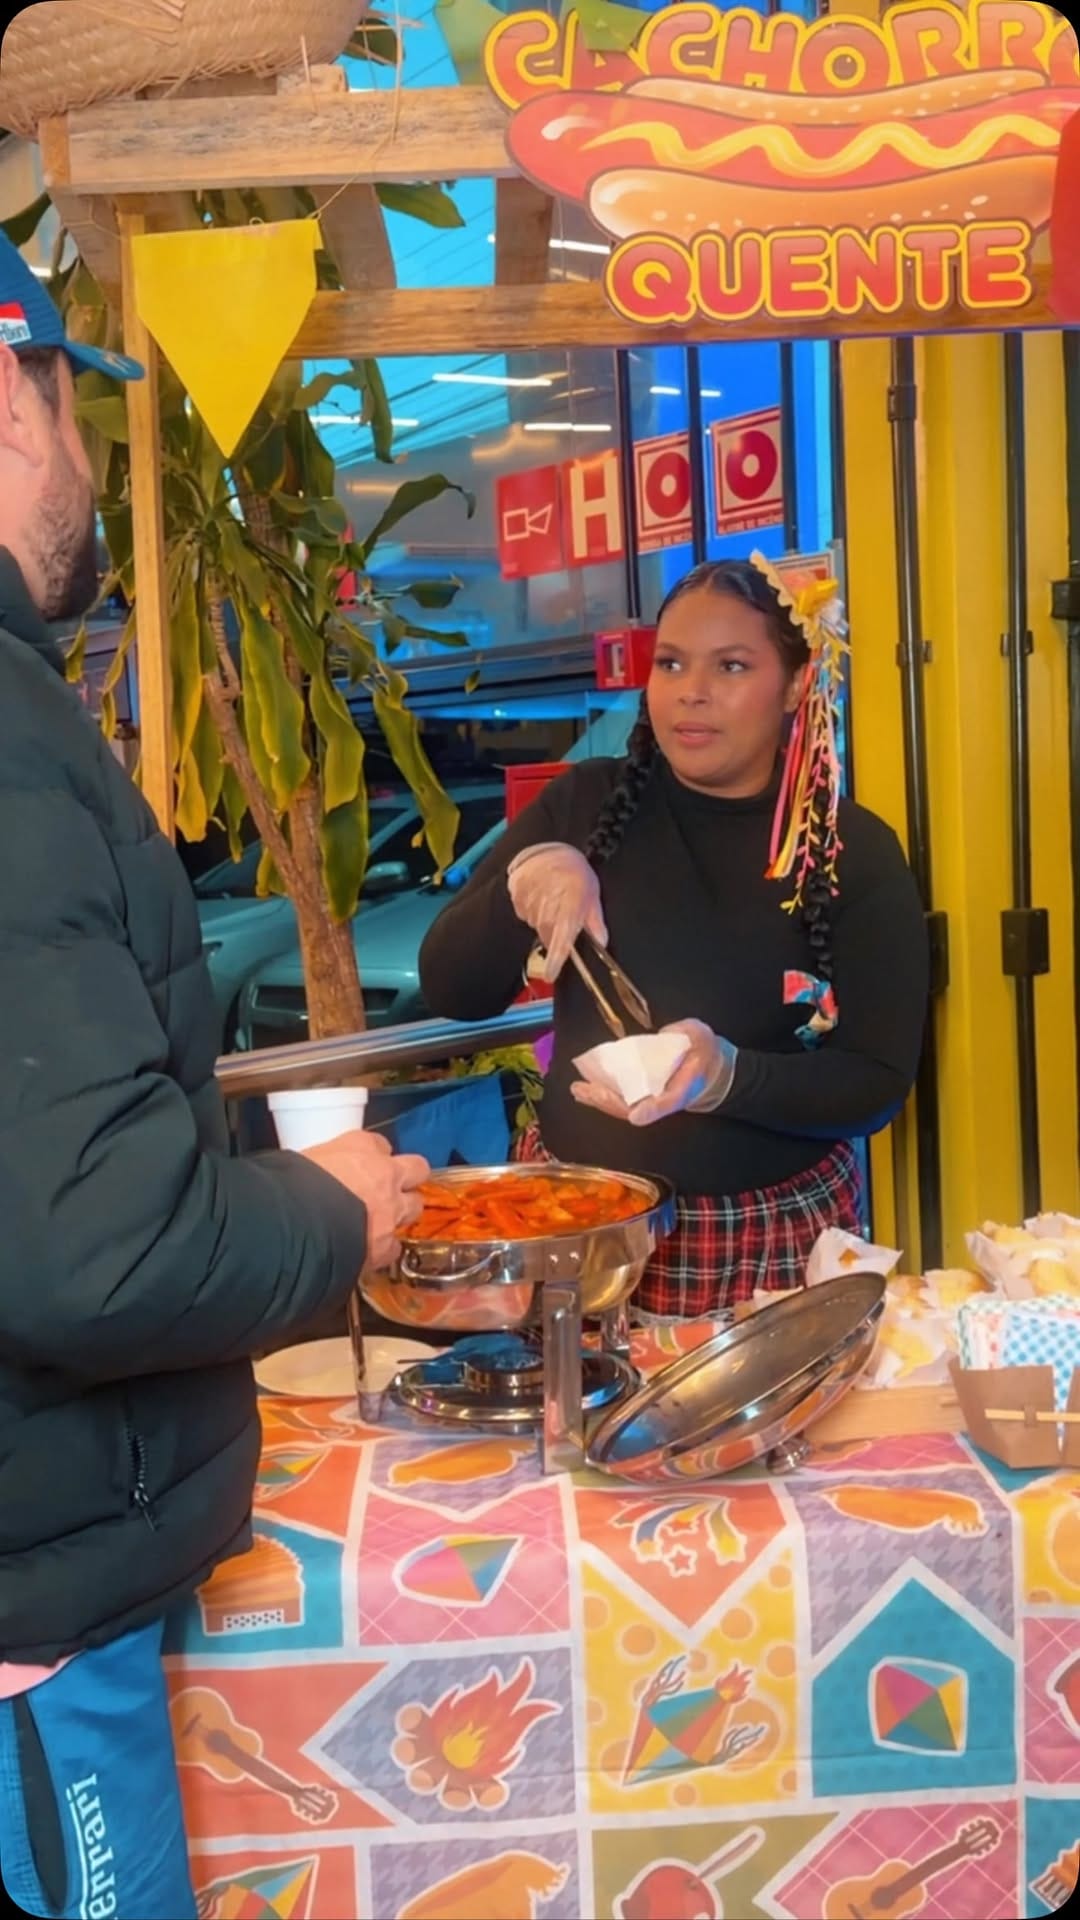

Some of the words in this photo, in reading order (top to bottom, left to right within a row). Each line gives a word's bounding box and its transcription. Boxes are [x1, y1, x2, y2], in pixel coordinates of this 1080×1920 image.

[605, 221, 1034, 324] QUENTE
[569, 456, 622, 558] H
[66, 1773, 118, 1919] errari
